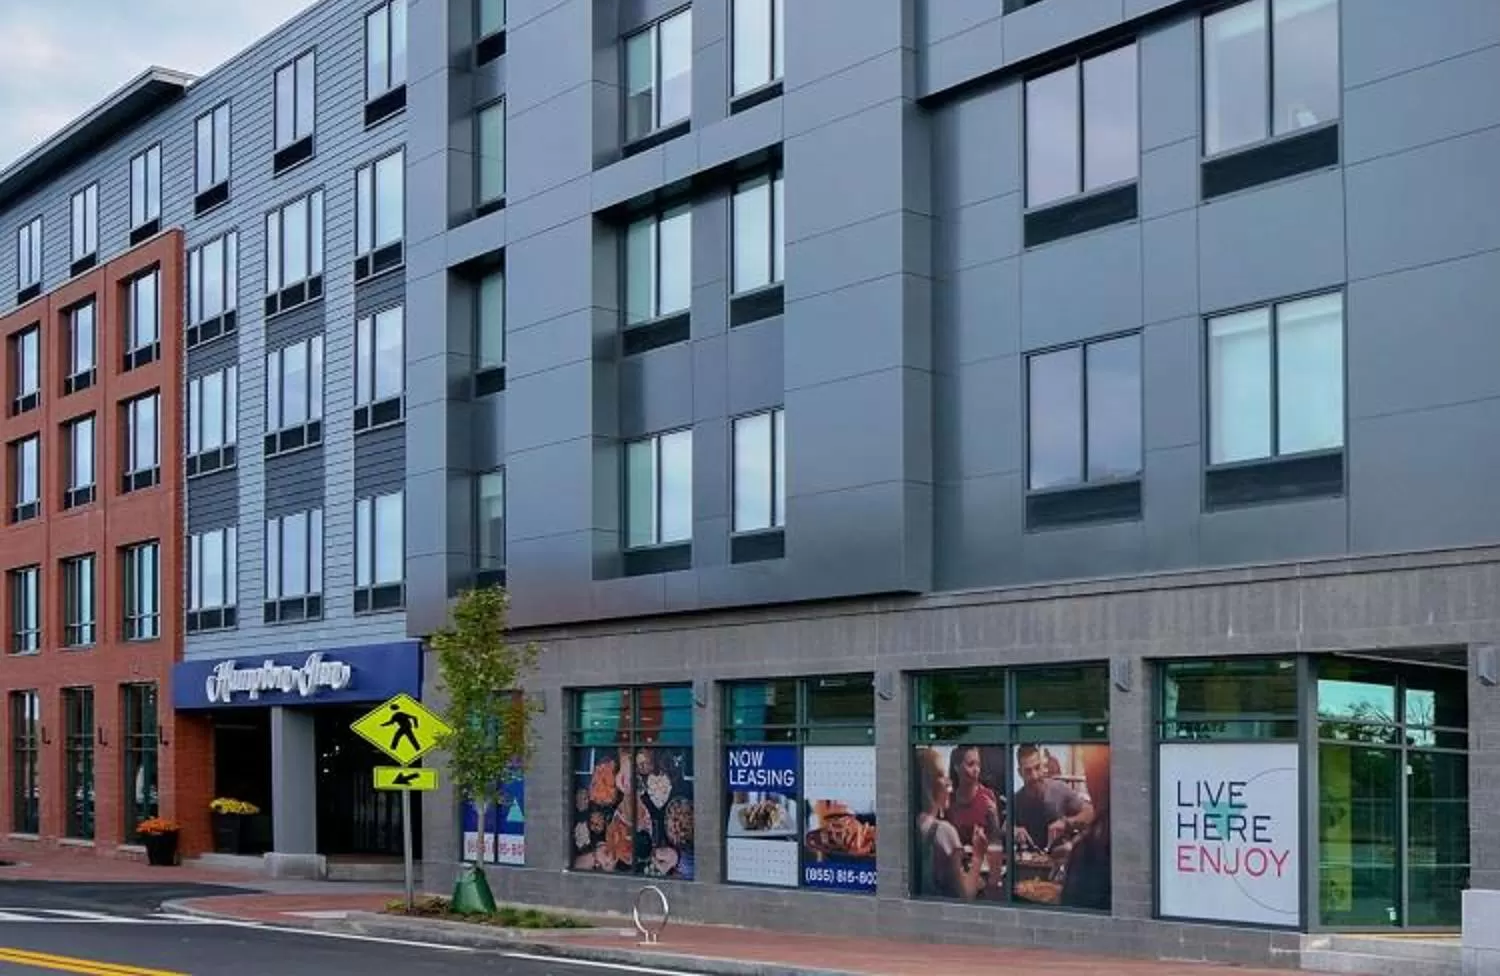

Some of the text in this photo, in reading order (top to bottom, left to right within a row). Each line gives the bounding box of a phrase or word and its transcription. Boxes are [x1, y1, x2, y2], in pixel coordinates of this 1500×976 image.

[729, 750, 765, 767] NOW
[729, 769, 795, 787] LEASING
[1177, 780, 1248, 809] LIVE
[1177, 812, 1273, 843] HERE
[1176, 845, 1291, 878] ENJOY
